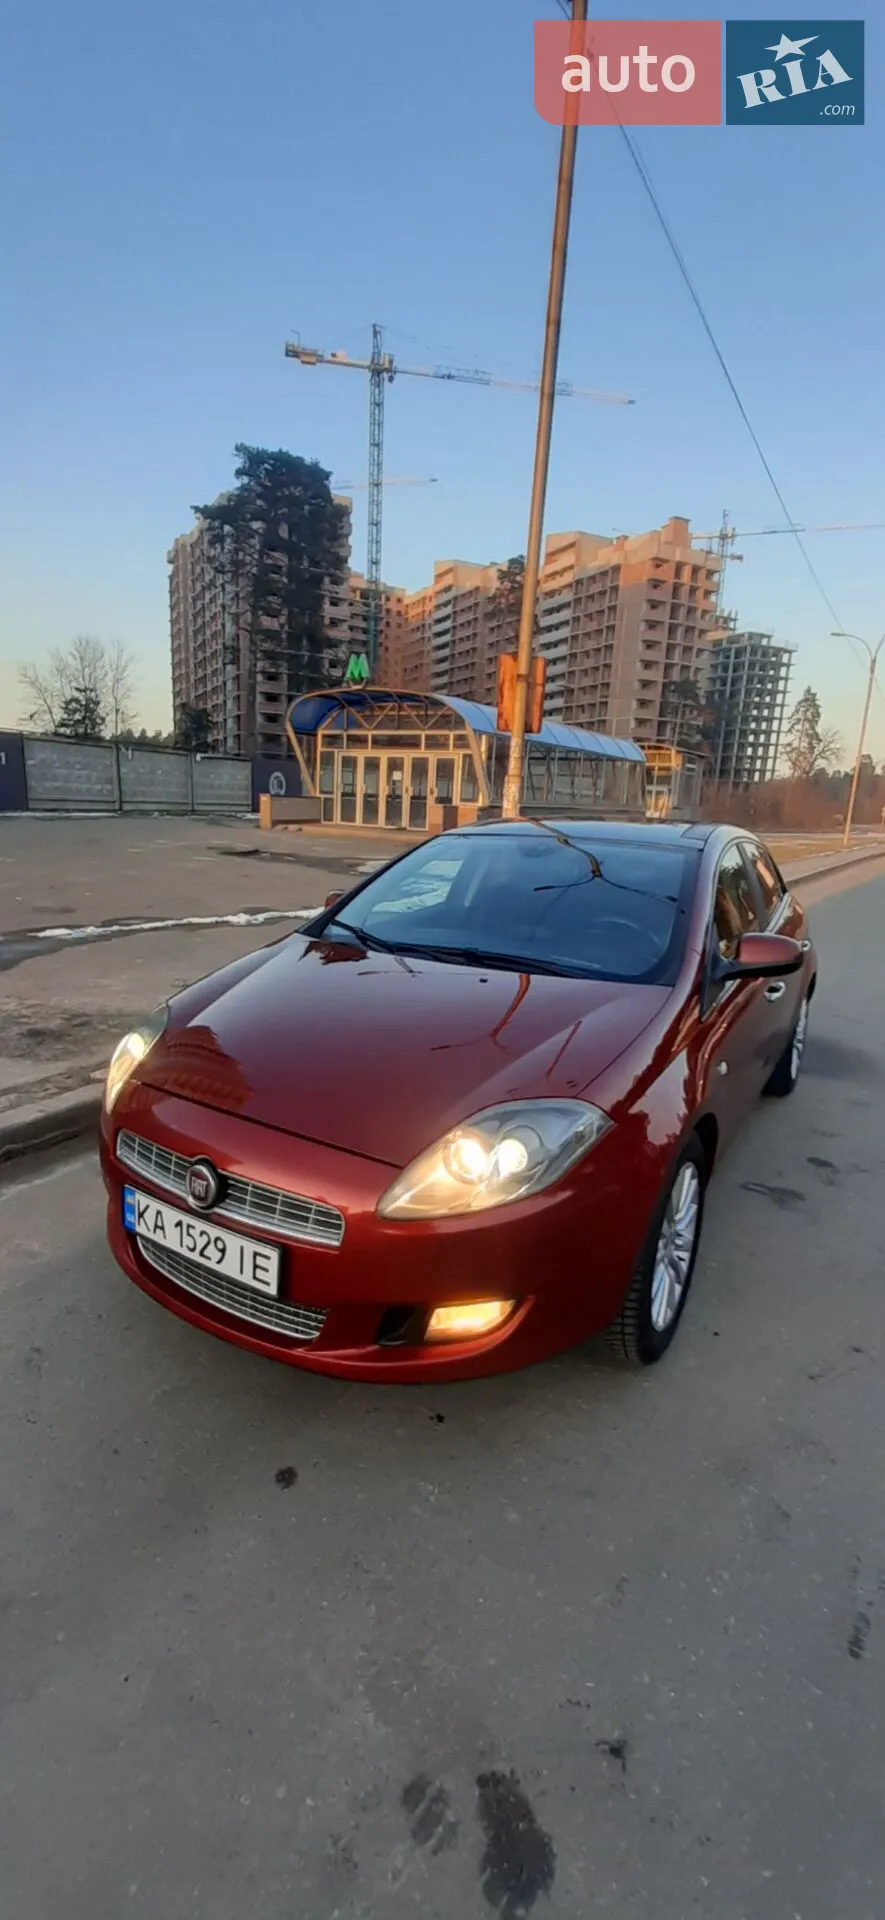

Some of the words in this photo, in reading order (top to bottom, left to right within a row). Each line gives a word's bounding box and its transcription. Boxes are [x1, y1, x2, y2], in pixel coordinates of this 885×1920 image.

[191, 1175, 208, 1198] FIAT
[137, 1199, 167, 1239] KA
[174, 1219, 227, 1265] 1529
[239, 1245, 271, 1287] IE
